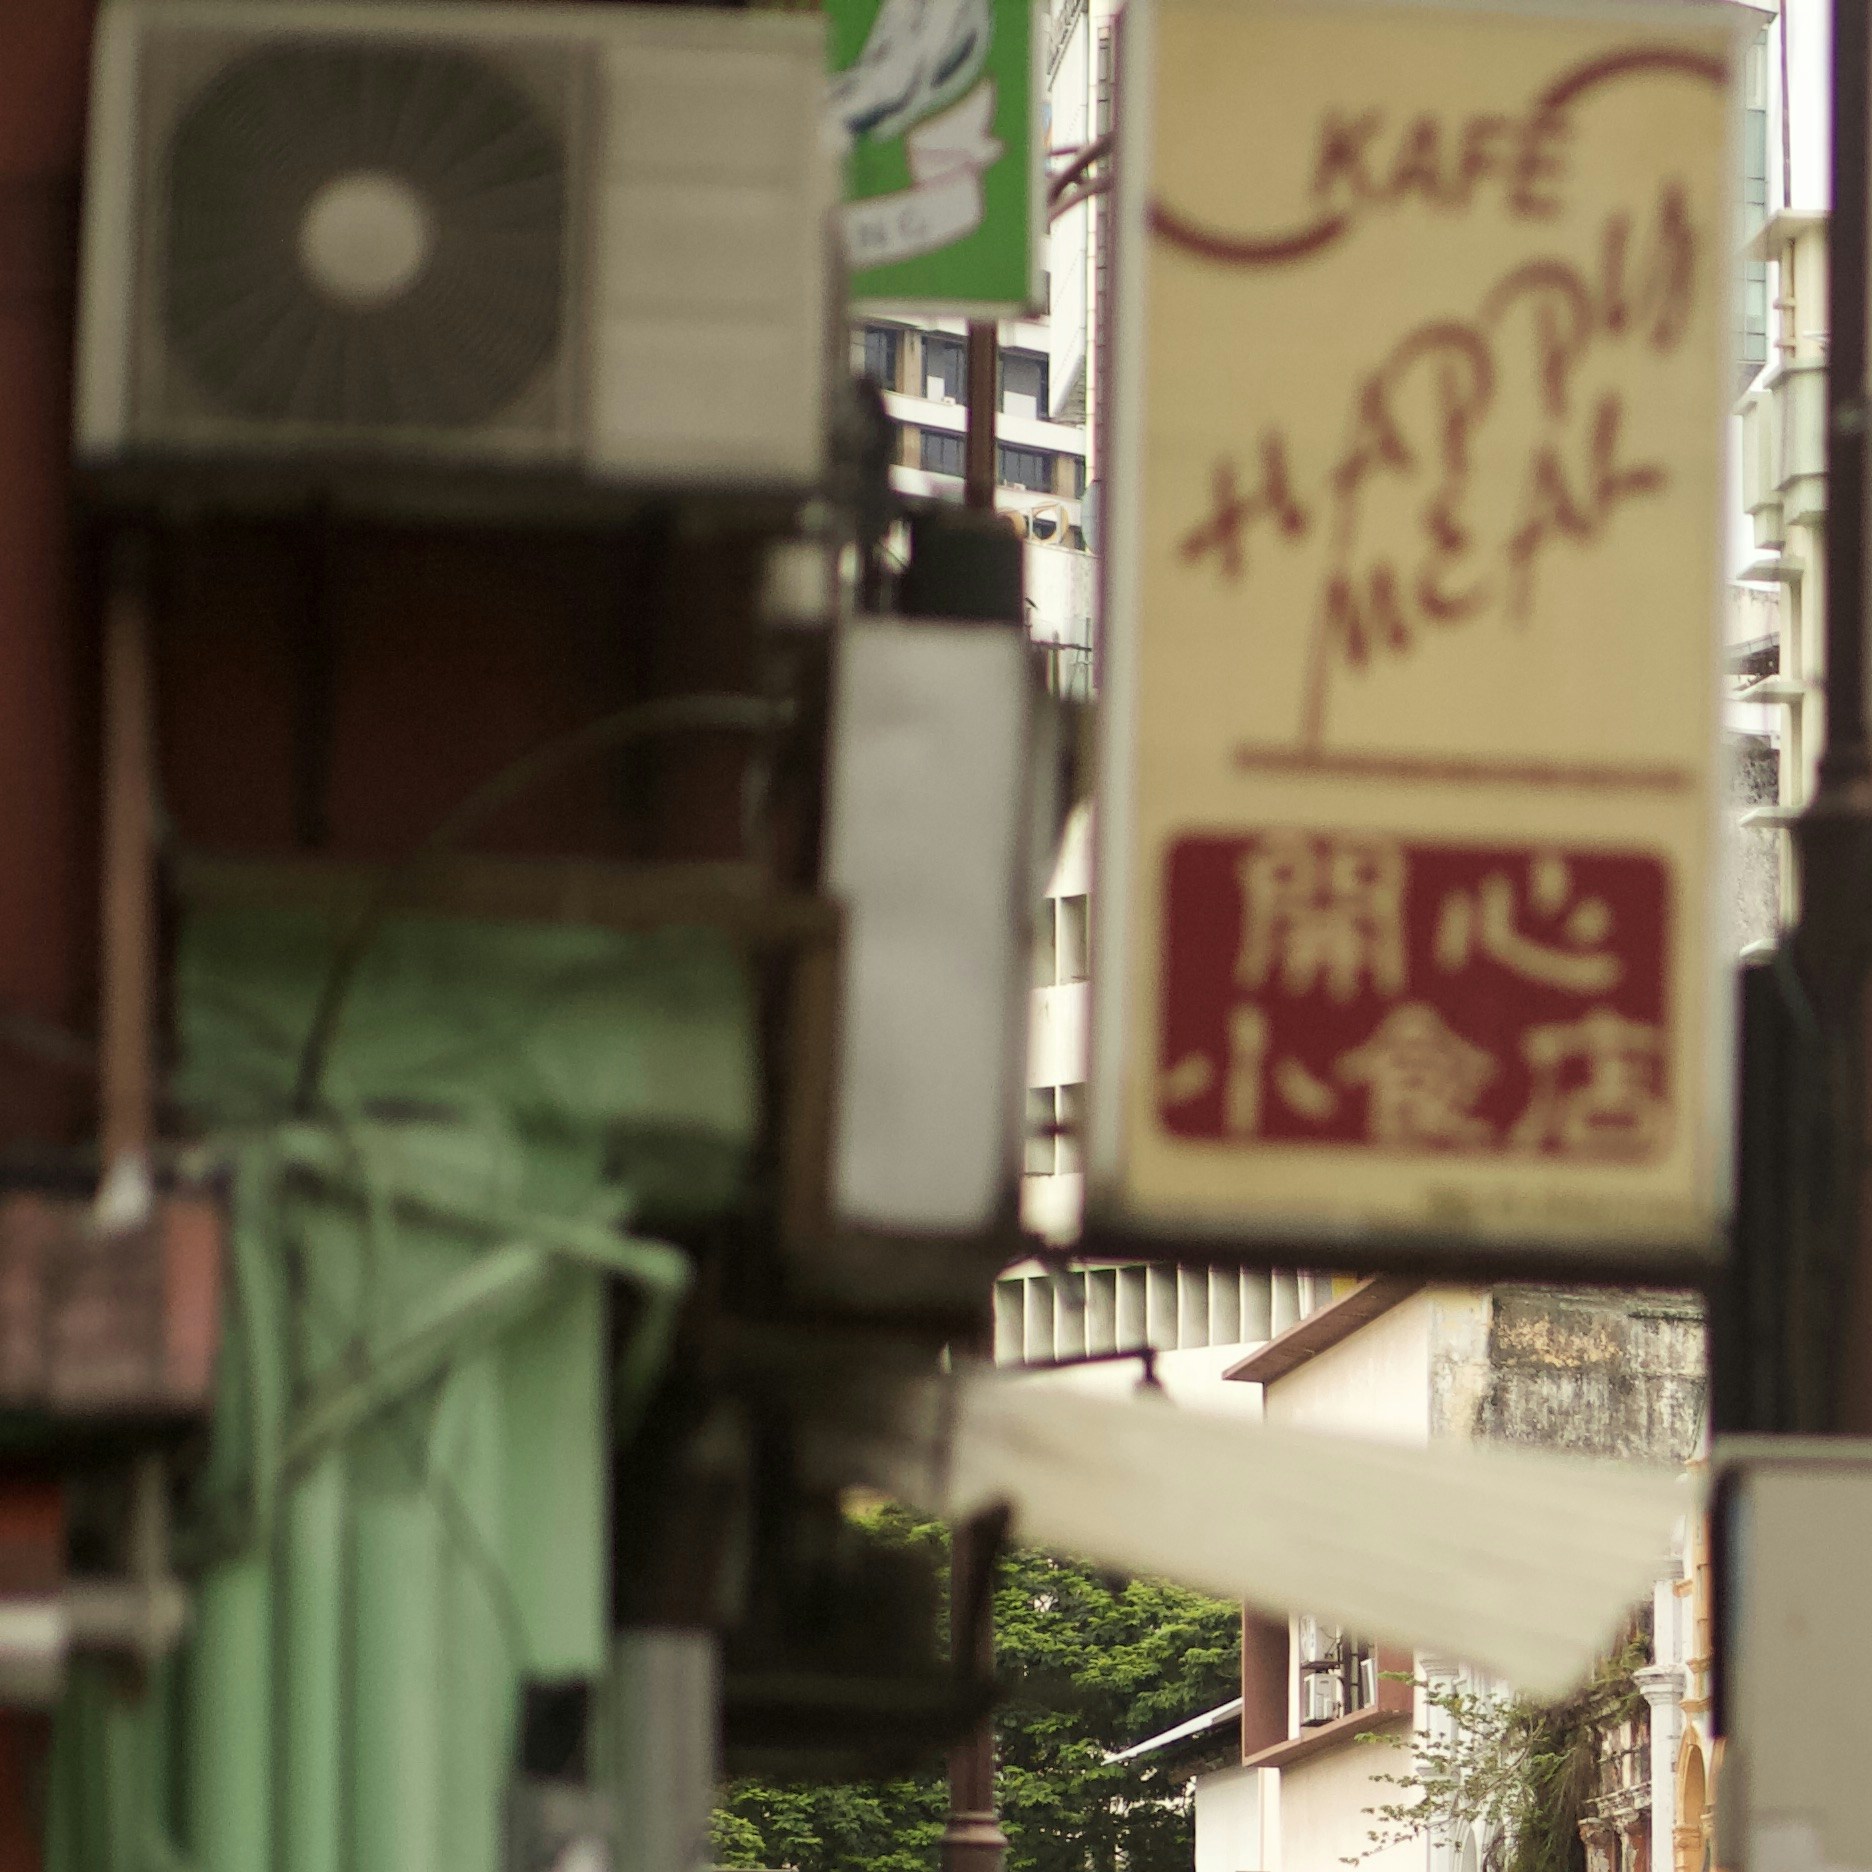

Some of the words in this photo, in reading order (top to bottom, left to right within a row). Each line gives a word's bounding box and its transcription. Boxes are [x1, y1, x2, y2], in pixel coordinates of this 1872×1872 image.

[1310, 107, 1576, 221] KAFE
[1235, 829, 1624, 1002] 開心
[1160, 1001, 1670, 1164] 小食店
